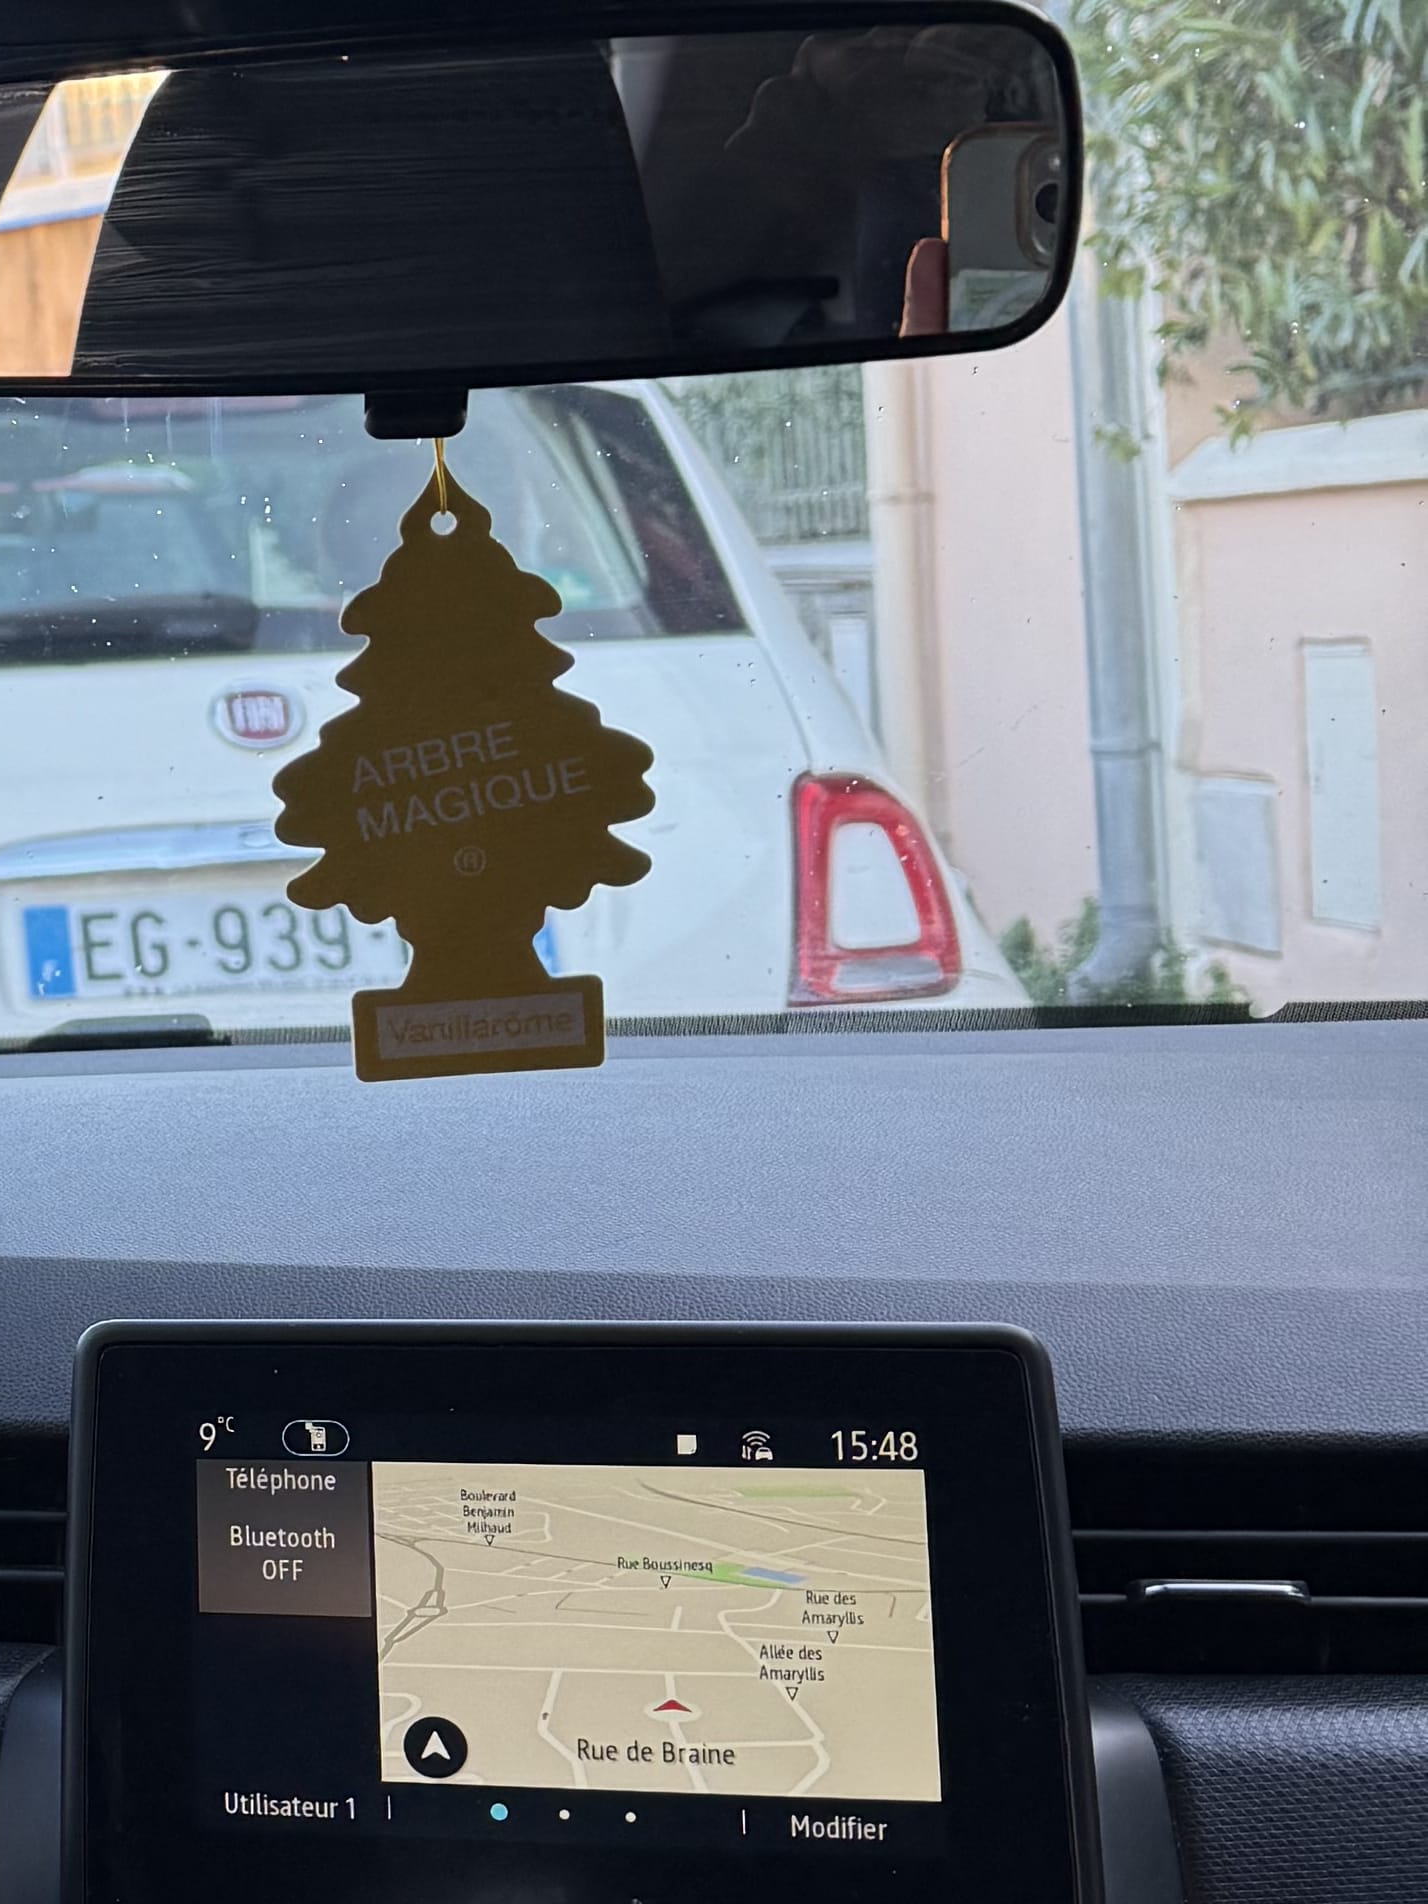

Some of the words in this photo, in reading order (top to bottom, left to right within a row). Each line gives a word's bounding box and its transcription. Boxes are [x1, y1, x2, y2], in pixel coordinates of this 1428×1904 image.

[351, 720, 520, 794] ARBRE
[355, 756, 592, 843] MAGIQUE
[79, 902, 413, 982] EG-939-
[830, 1430, 919, 1462] 15:48
[224, 1467, 337, 1496] Téléphone
[459, 1488, 517, 1502] Boulevard
[462, 1504, 515, 1520] Benjamin
[229, 1524, 336, 1550] Bluetooth
[466, 1521, 512, 1534] Milhaud
[262, 1559, 304, 1582] OFF
[616, 1556, 639, 1571] Rue
[642, 1557, 714, 1574] Boussinesq
[804, 1590, 830, 1606] Rue
[832, 1591, 857, 1606] des
[801, 1610, 865, 1629] Amaryllis
[758, 1644, 794, 1661] Allée
[798, 1645, 823, 1661] des
[758, 1664, 825, 1684] Amaryllis
[576, 1737, 618, 1762] Rue
[626, 1739, 654, 1764] de
[662, 1741, 736, 1766] Braine
[224, 1791, 339, 1819] Utilisateur
[344, 1797, 355, 1820] 1
[790, 1813, 888, 1842] Modifier
